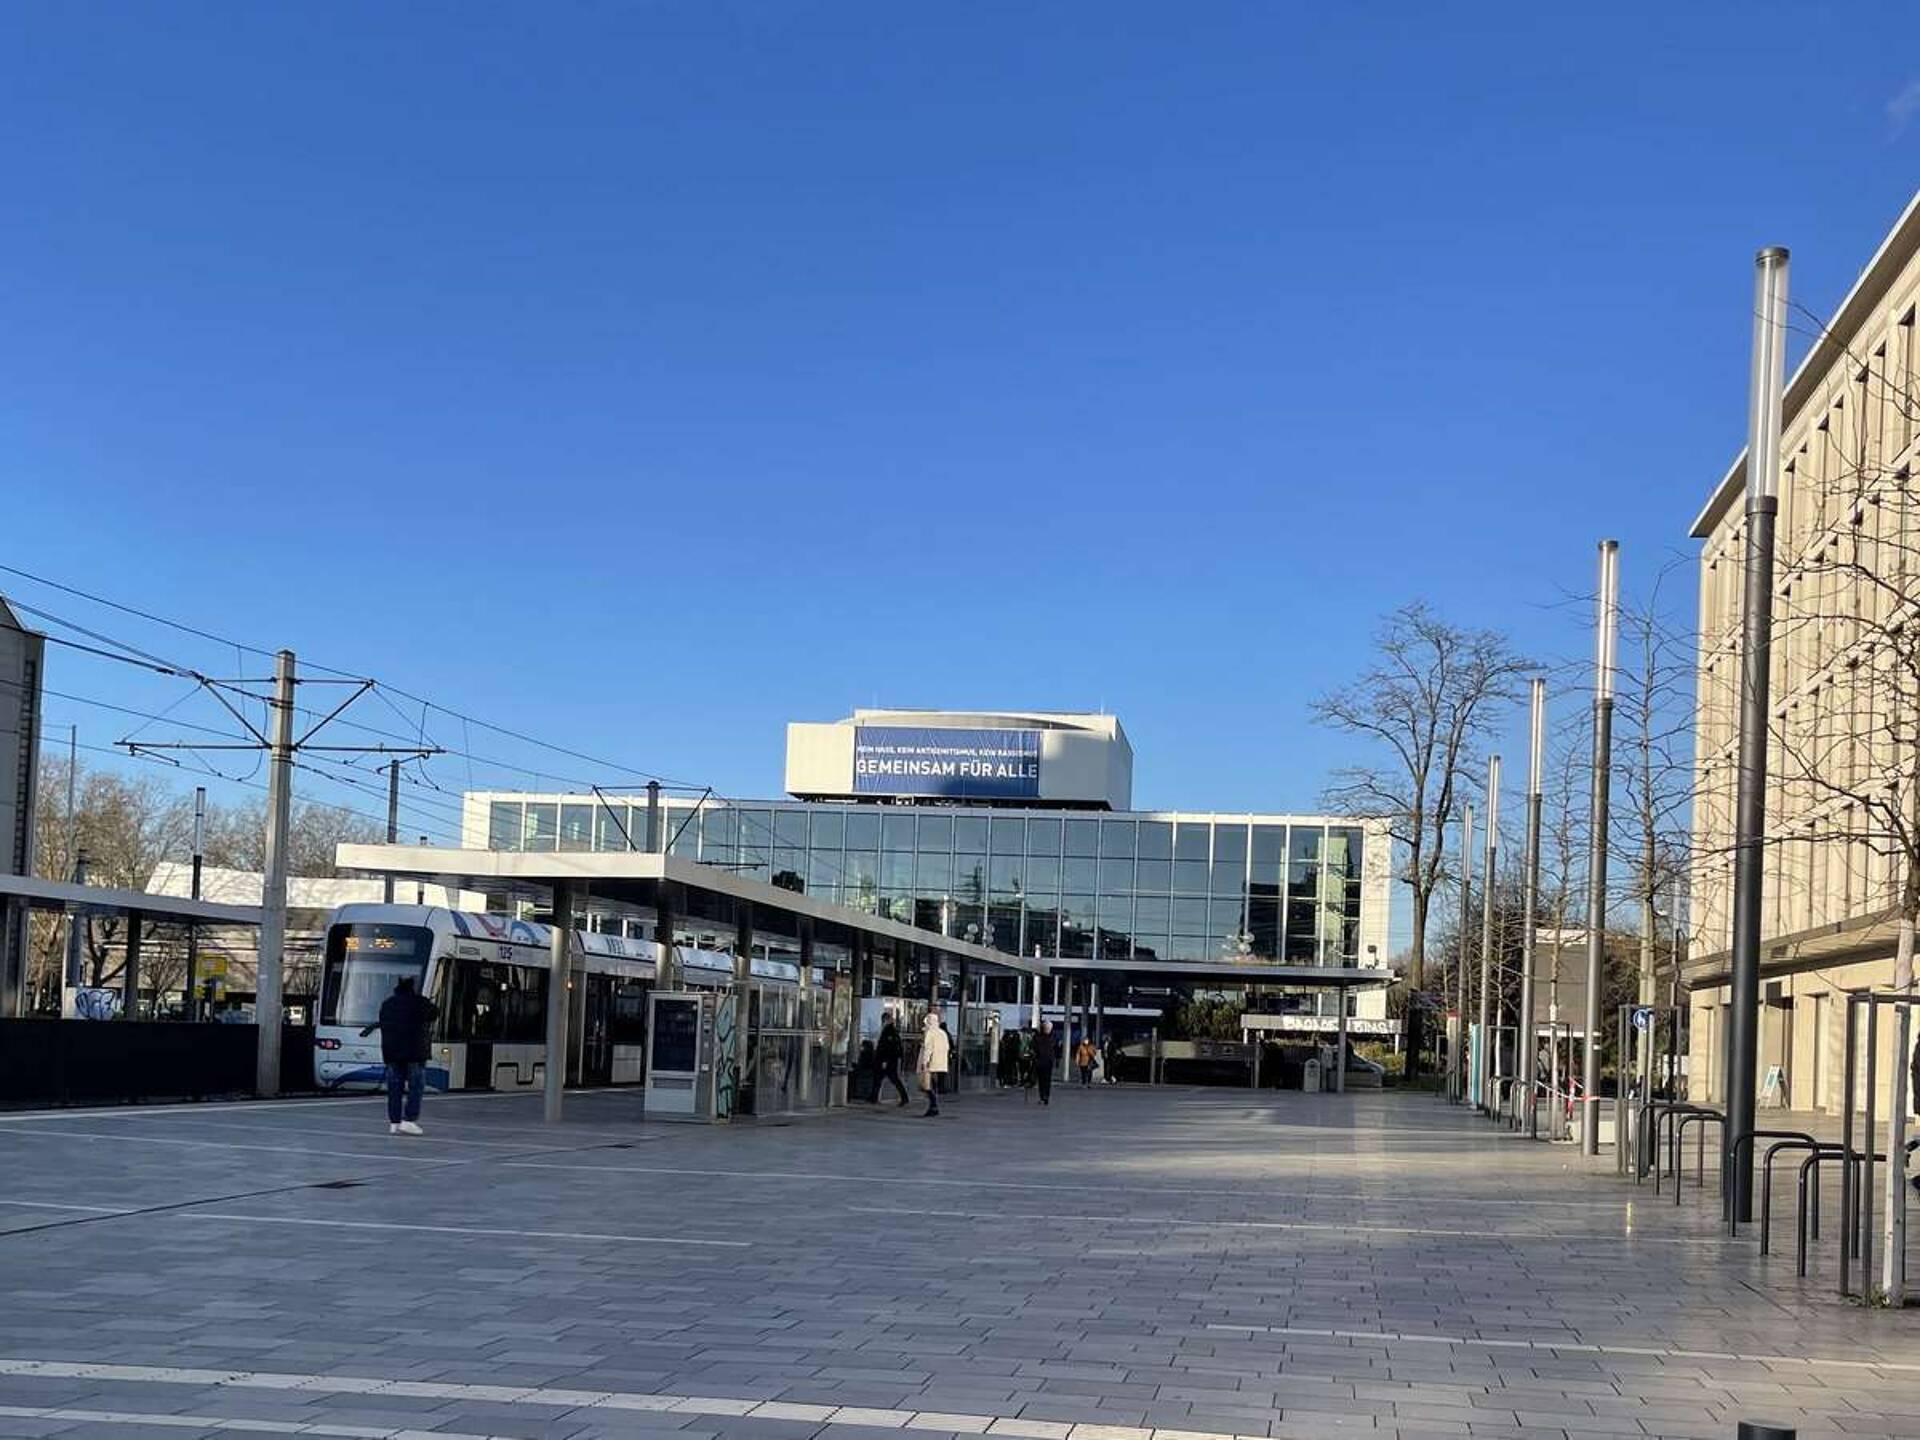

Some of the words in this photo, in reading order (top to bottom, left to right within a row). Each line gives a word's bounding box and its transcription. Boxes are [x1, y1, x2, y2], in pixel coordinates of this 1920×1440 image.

[857, 759, 955, 776] GEMEINSAM
[960, 759, 993, 776] FÜR
[996, 763, 1037, 778] ALLE
